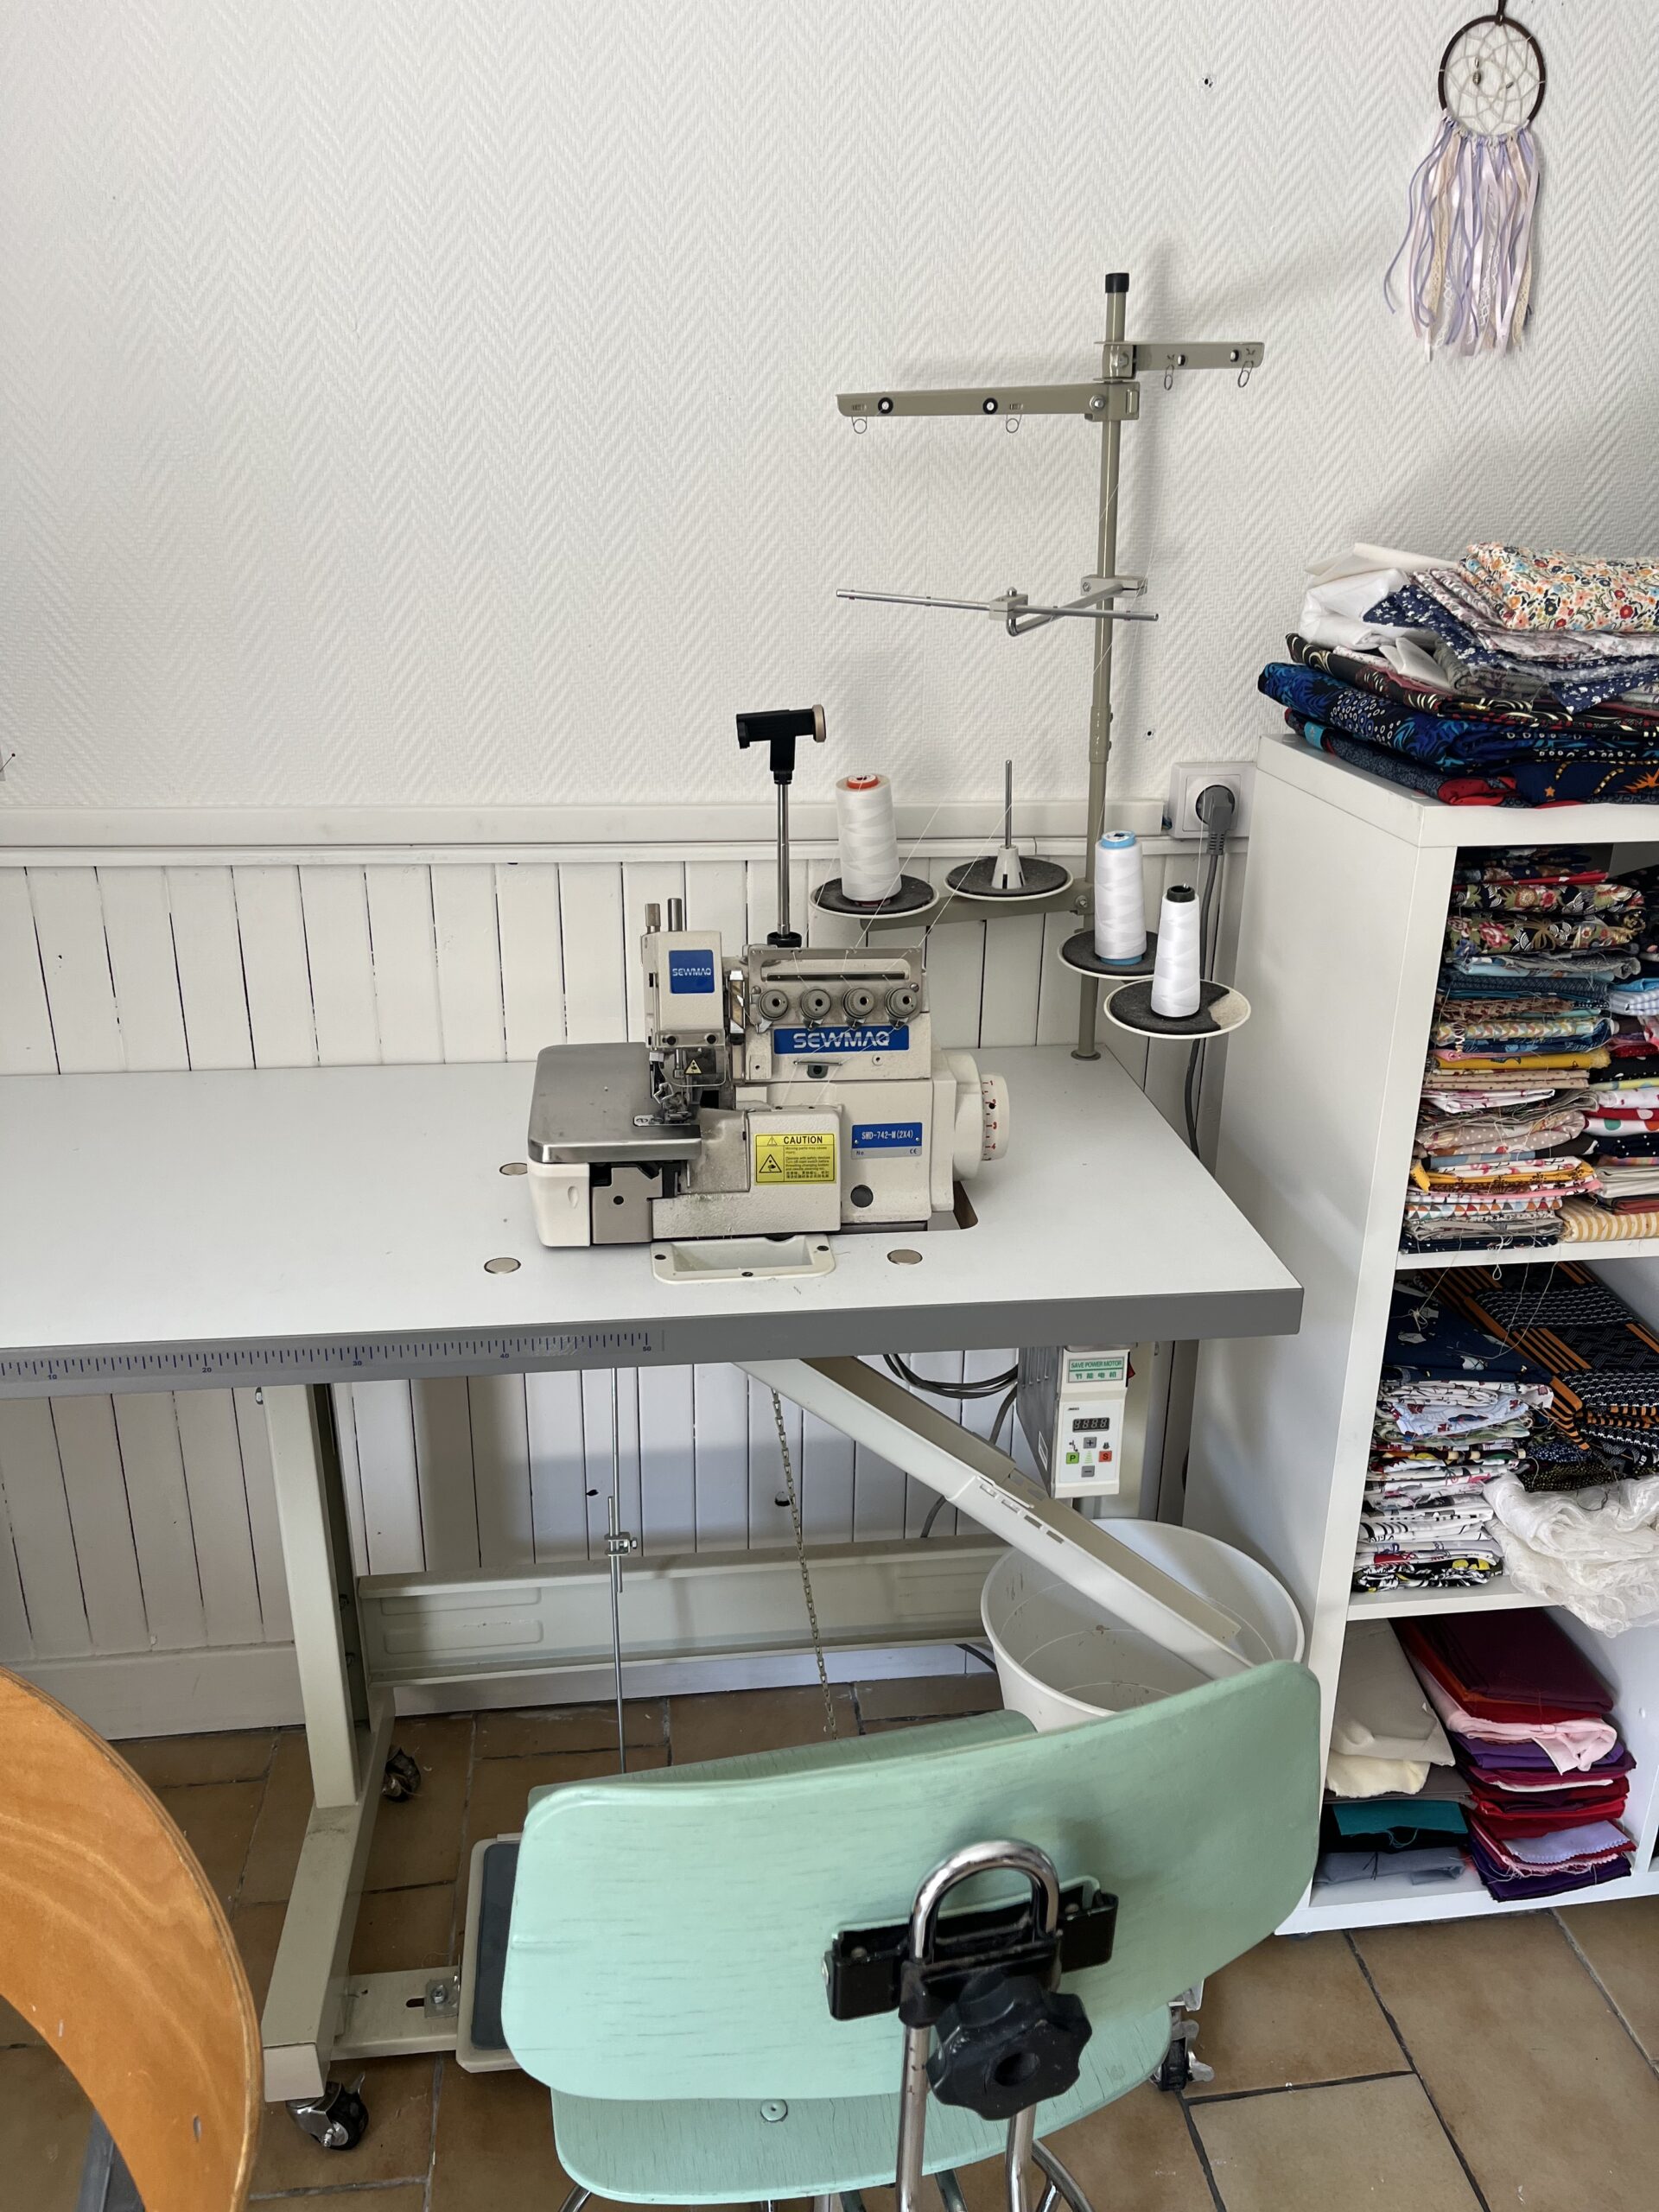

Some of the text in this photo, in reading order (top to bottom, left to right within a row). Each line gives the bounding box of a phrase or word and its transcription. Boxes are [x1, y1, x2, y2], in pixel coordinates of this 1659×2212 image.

[671, 967, 711, 976] SEWMAQ
[793, 1031, 891, 1048] SEWMAQ
[783, 1135, 823, 1145] CAUTION
